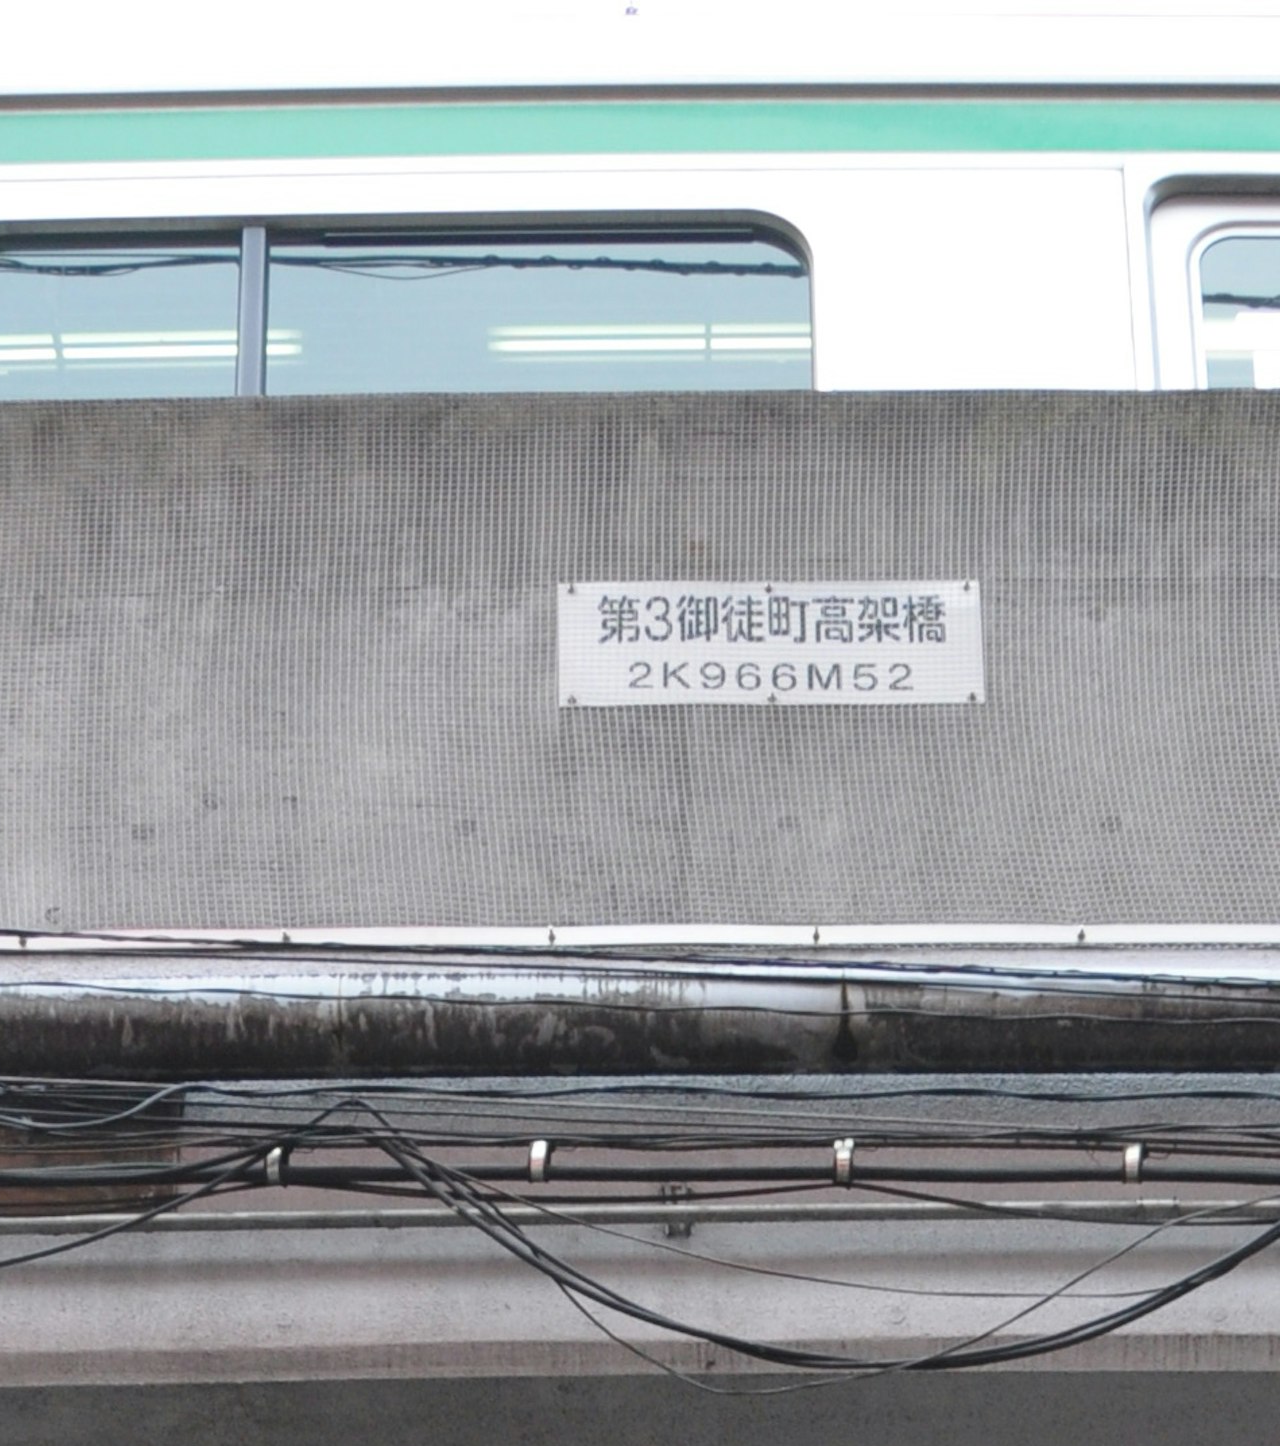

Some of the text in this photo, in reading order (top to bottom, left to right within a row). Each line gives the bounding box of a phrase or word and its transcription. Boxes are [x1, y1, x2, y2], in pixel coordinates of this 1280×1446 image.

[596, 594, 947, 645] 第3御徒町高架橋
[627, 661, 916, 692] 2K966M52
